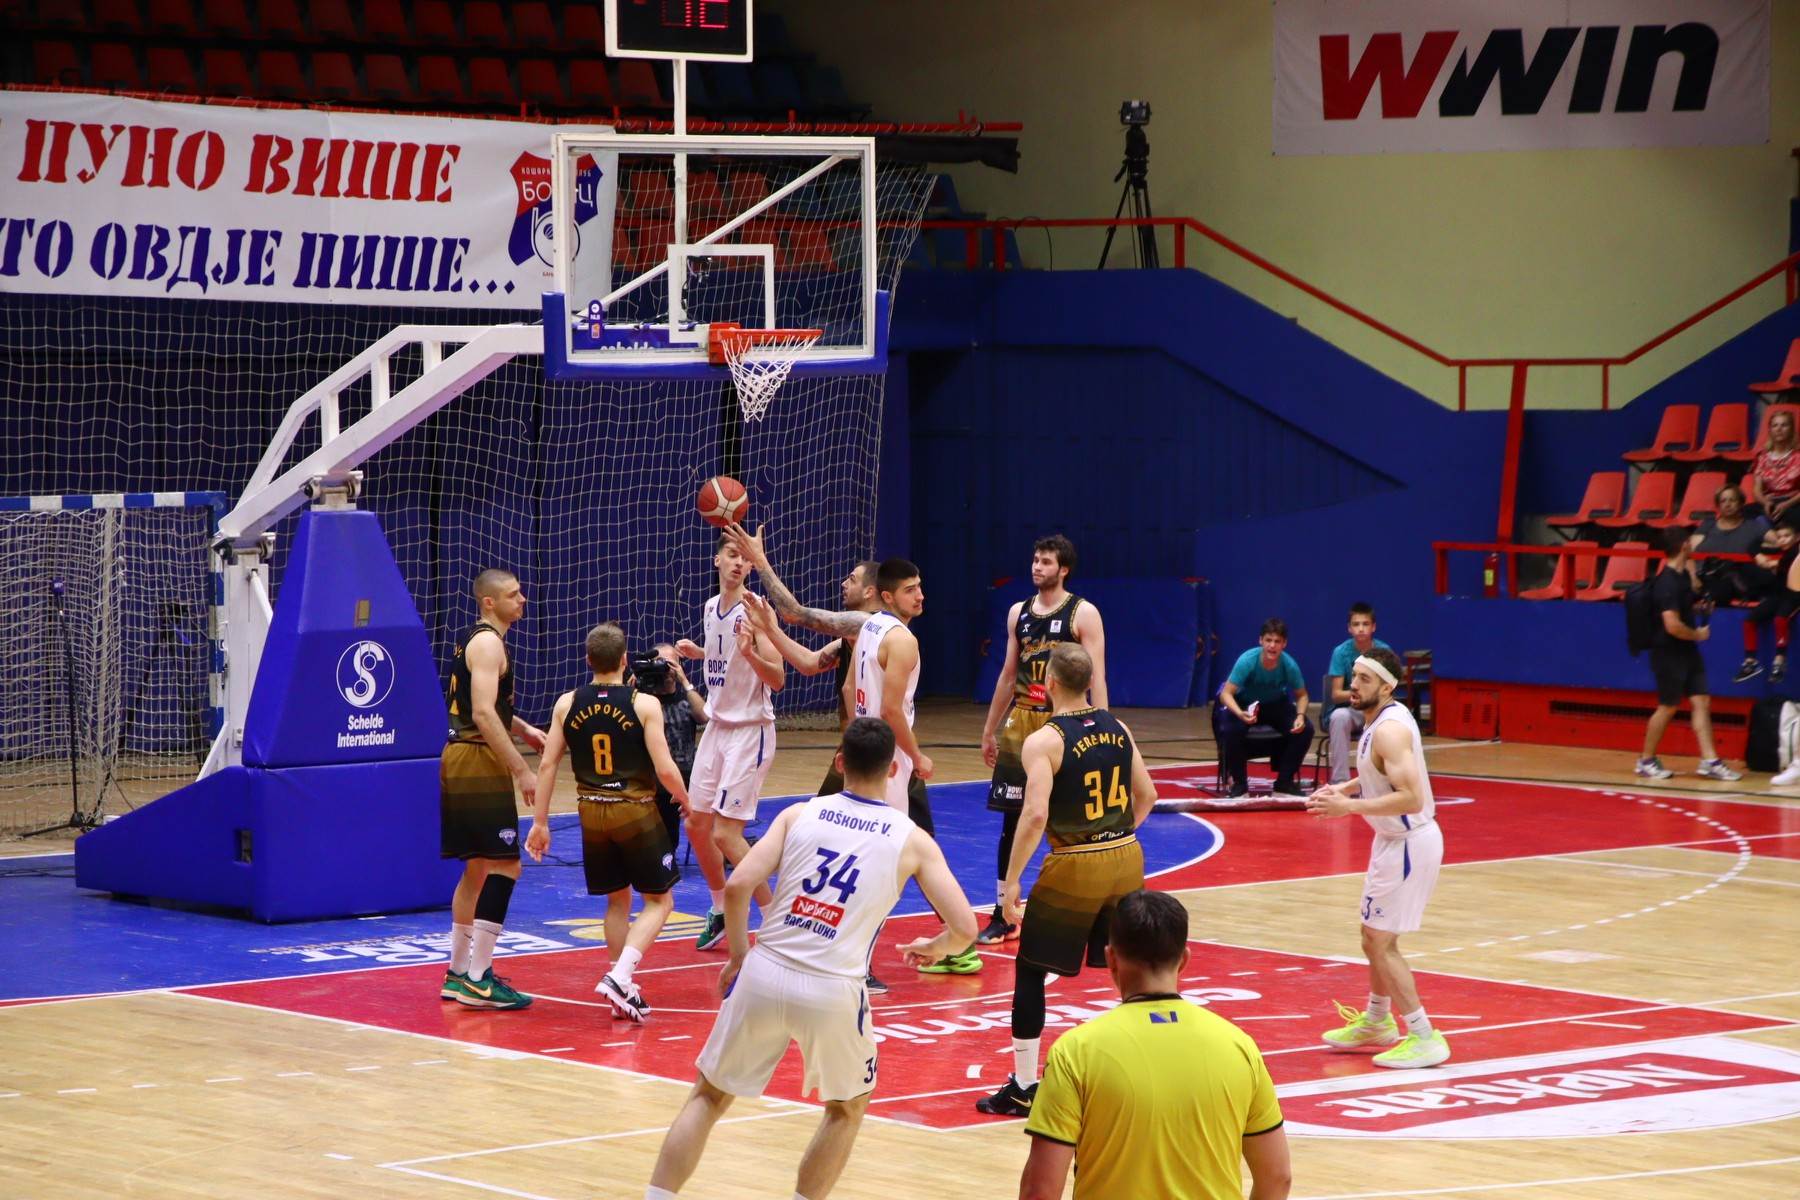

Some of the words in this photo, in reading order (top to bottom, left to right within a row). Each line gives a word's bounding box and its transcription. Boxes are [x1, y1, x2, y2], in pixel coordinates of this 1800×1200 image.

[17, 119, 226, 191] ПУНО
[245, 133, 461, 203] ВИШЕ
[91, 222, 283, 295] ОВДЈЕ
[293, 231, 516, 295] ПИШЕ...
[337, 729, 395, 748] International
[347, 713, 384, 730] Schelde
[570, 704, 634, 731] FILIPOVIĆ
[592, 733, 613, 776] 8
[1072, 733, 1125, 758] JEREMIĆ
[1084, 766, 1129, 820] 34
[818, 808, 880, 833] BOŠKOVIĆ
[881, 822, 892, 837] V.
[802, 847, 860, 904] 34
[1340, 1062, 1746, 1118] Nektar
